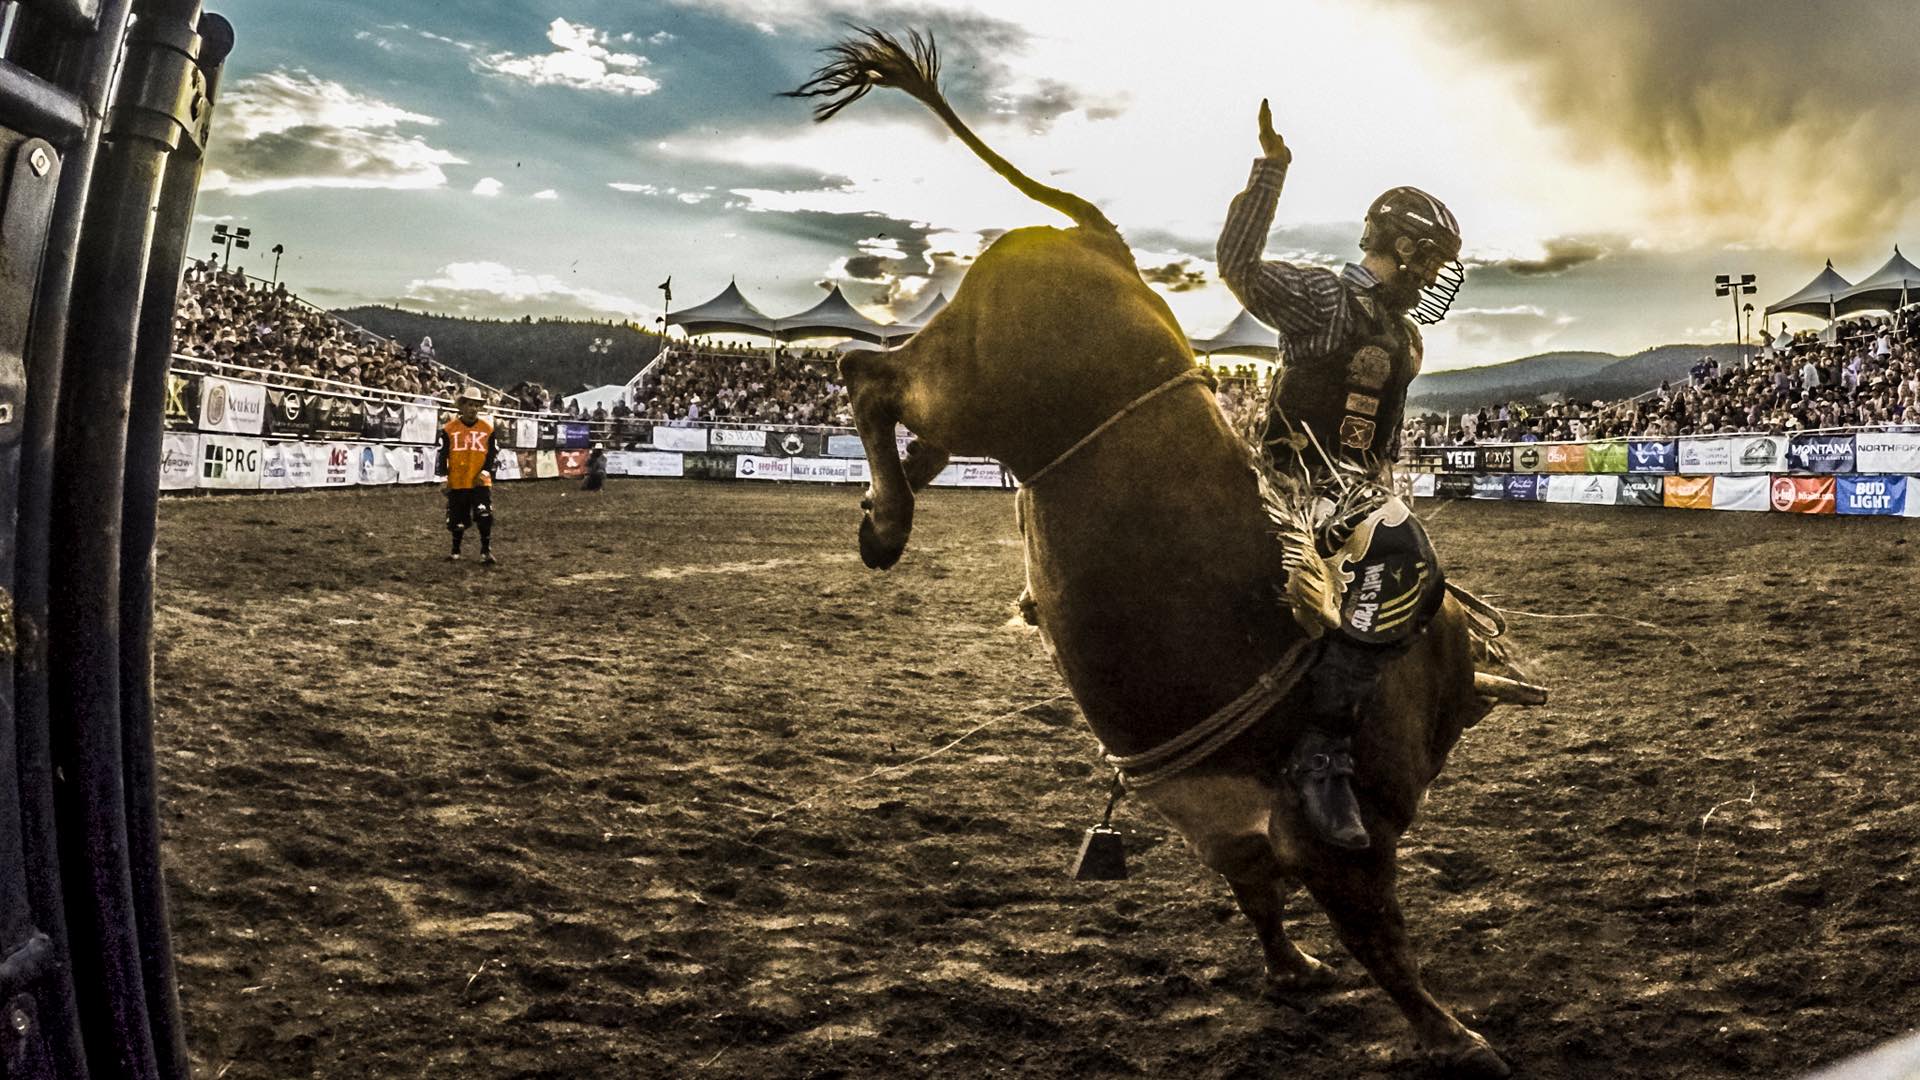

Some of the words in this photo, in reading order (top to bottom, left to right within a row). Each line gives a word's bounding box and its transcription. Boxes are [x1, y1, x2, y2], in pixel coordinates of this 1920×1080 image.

[328, 447, 349, 466] ACE
[1792, 443, 1852, 456] MONTANA
[225, 447, 257, 472] PRG
[1447, 451, 1476, 465] YETI
[1856, 482, 1885, 495] BUD
[1849, 495, 1890, 509] LIGHT
